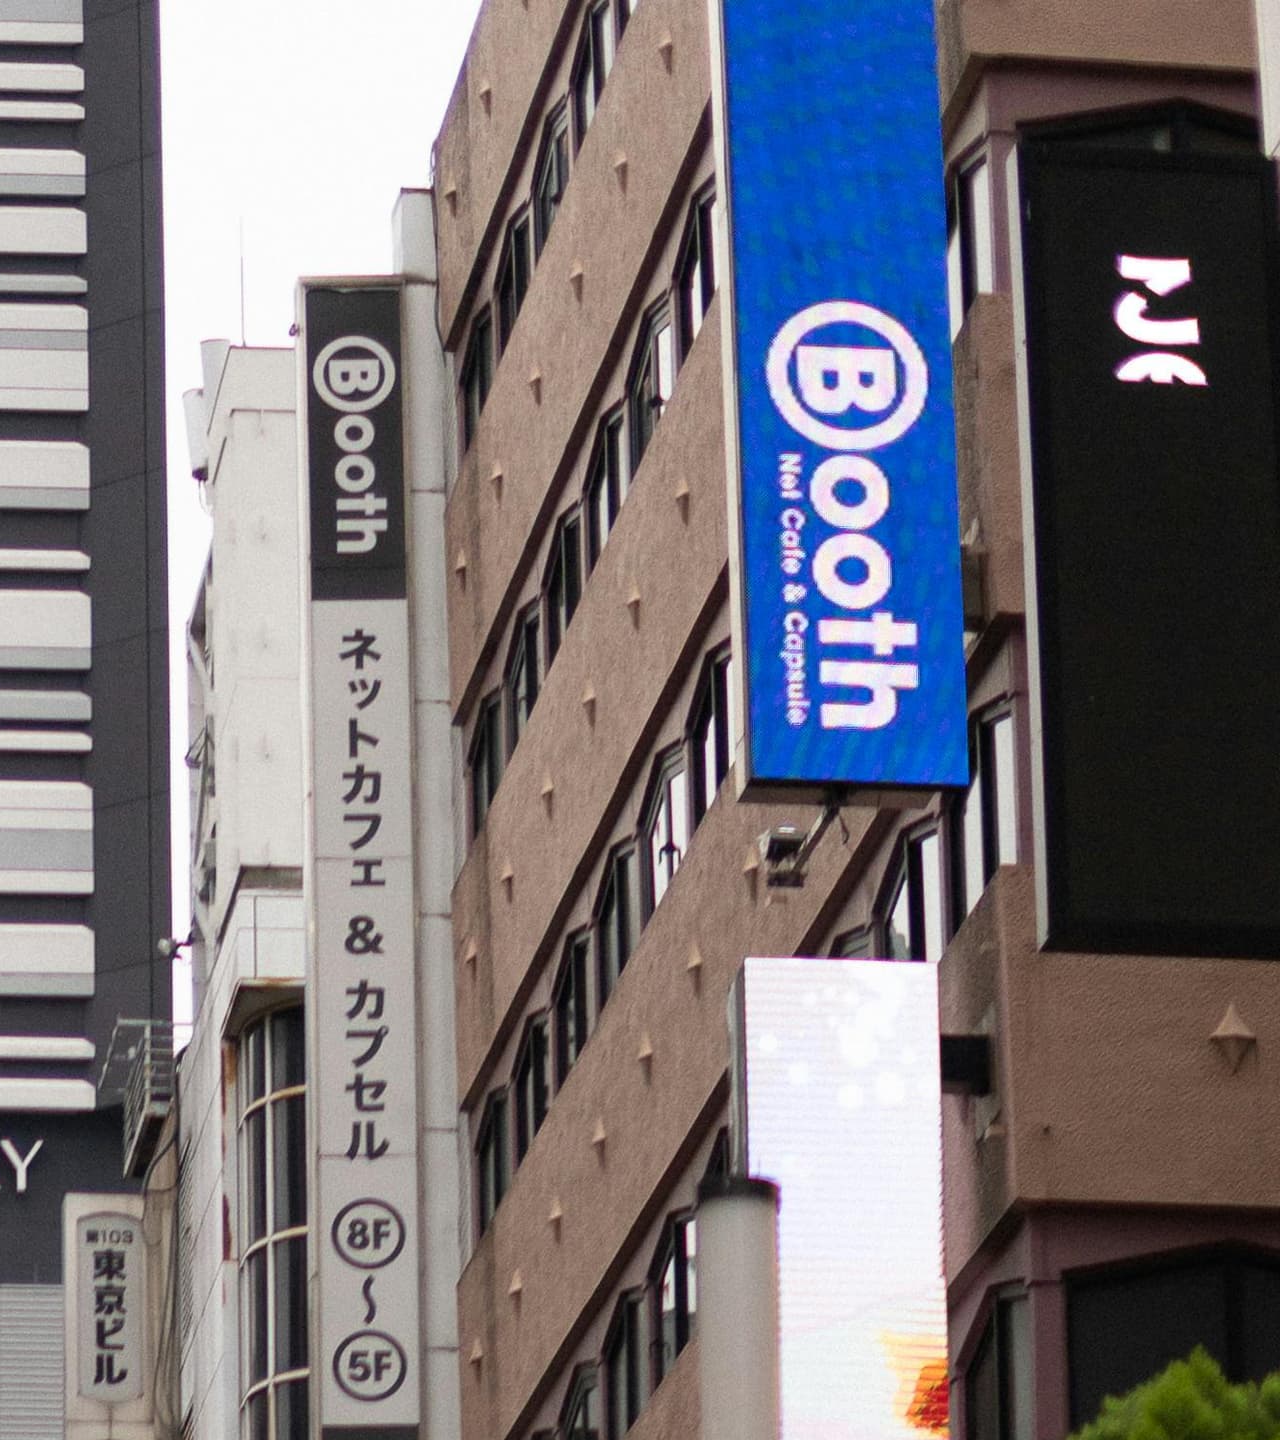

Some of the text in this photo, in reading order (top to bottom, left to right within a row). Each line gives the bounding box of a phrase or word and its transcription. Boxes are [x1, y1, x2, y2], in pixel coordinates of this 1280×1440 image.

[312, 336, 396, 555] Booth
[766, 300, 930, 732] Booth
[346, 1218, 391, 1251] 8F
[93, 1249, 130, 1385] 東京ビル
[348, 1349, 393, 1383] 5F
